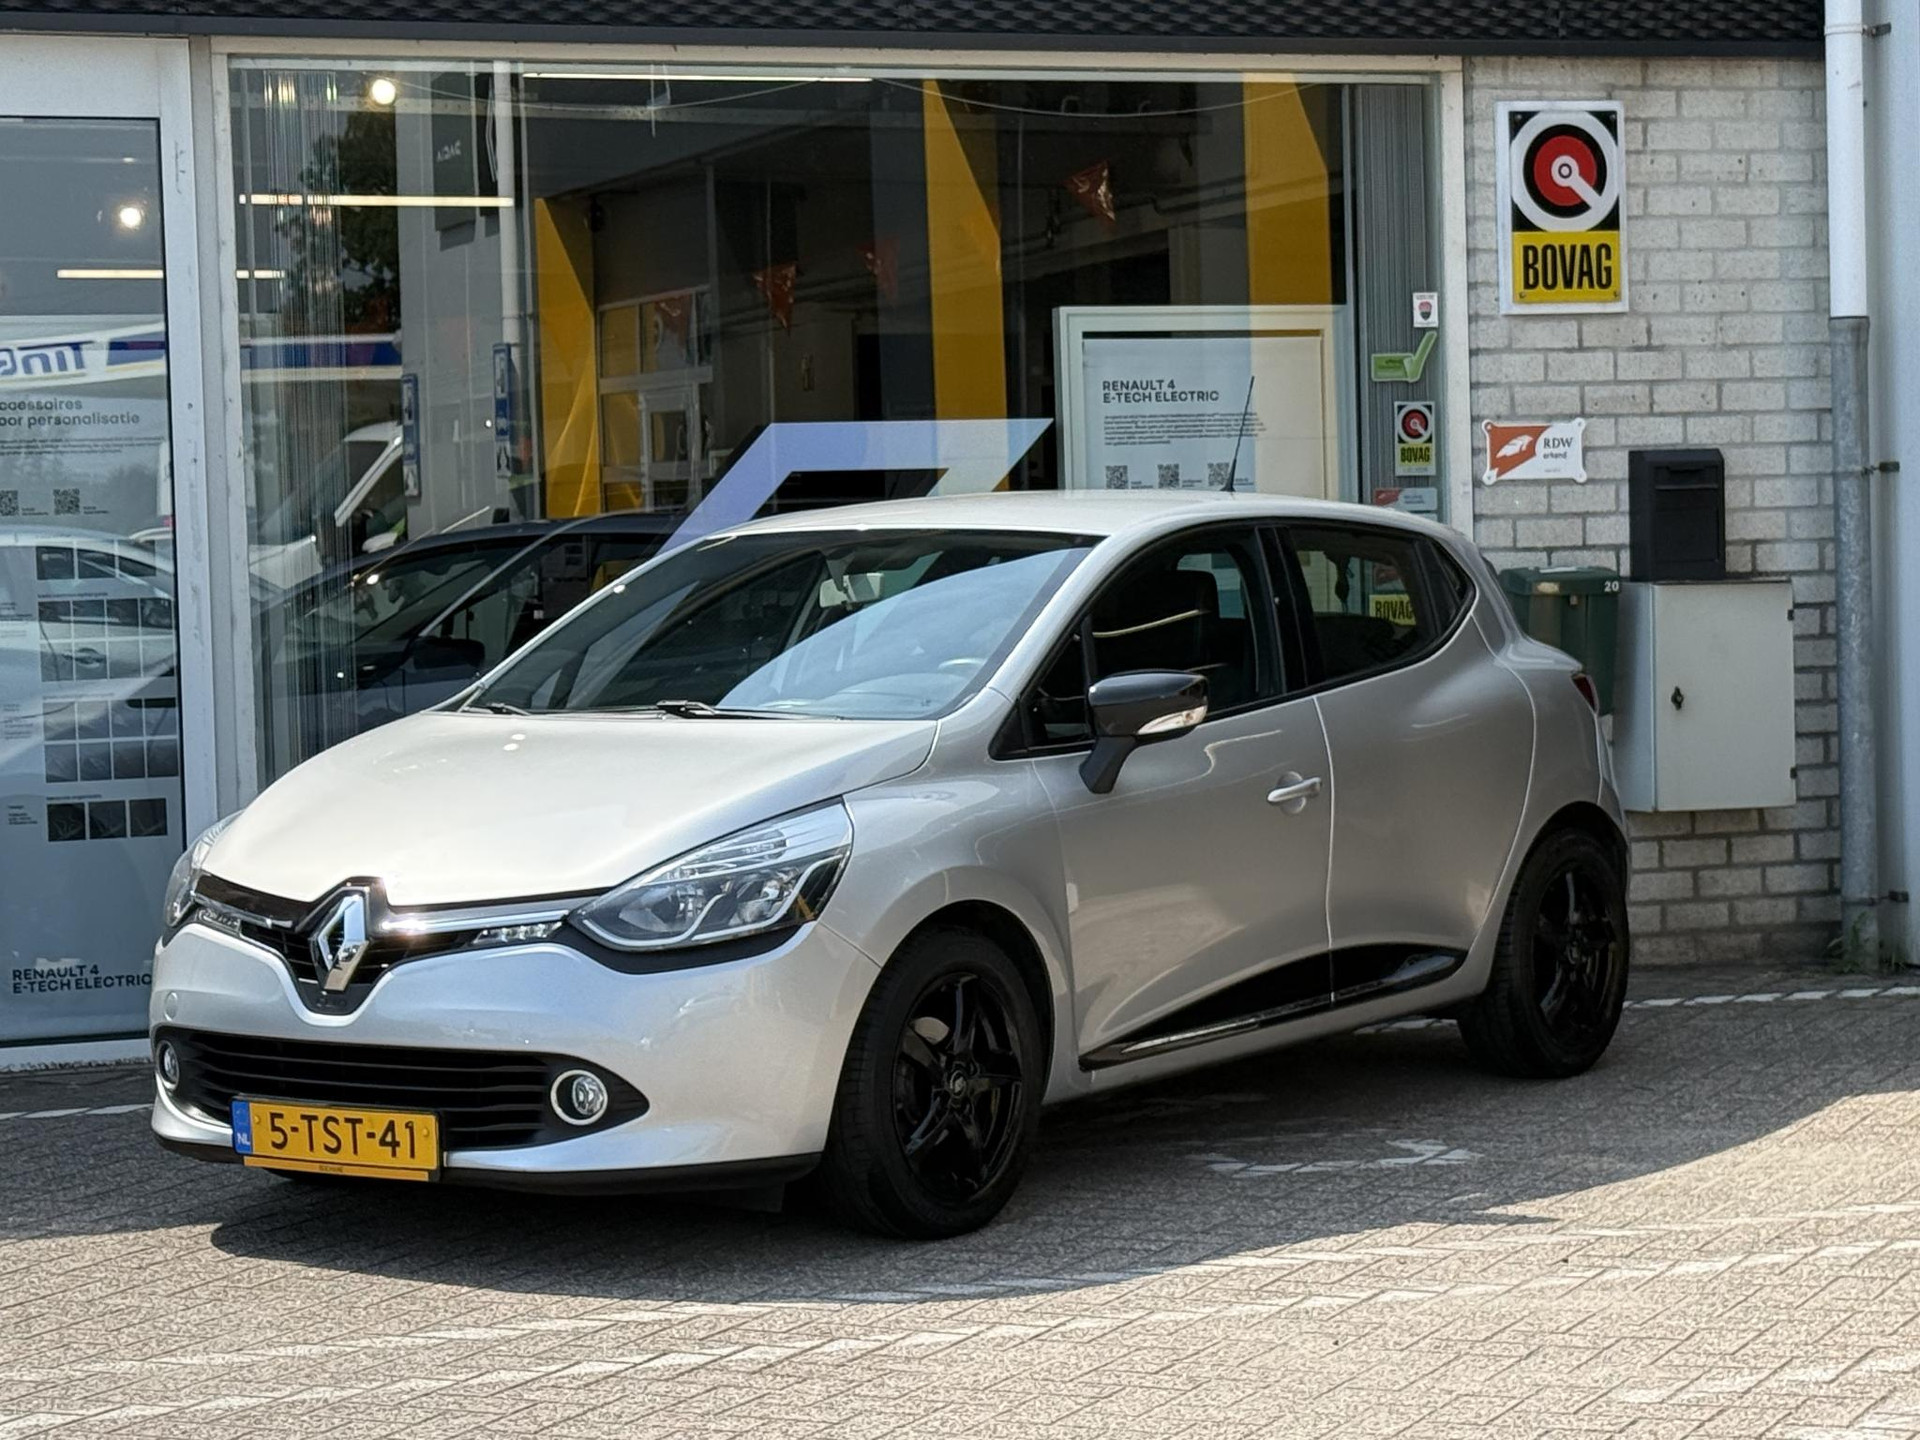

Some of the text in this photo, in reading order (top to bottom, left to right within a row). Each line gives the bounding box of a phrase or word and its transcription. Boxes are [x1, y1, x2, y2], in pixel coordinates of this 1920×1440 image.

[1522, 243, 1612, 290] BOVAG
[1102, 379, 1176, 391] RENAULT 4
[1103, 390, 1220, 403] E-TECH ELECTRIC
[27, 412, 140, 428] personalisatie
[1543, 437, 1573, 449] RDW
[1400, 447, 1431, 463] BOVAG
[1604, 580, 1620, 592] 20
[12, 964, 100, 981] RENAULT 4
[13, 979, 71, 994] E-TECH
[237, 1111, 416, 1159] NL 5-TST-41
